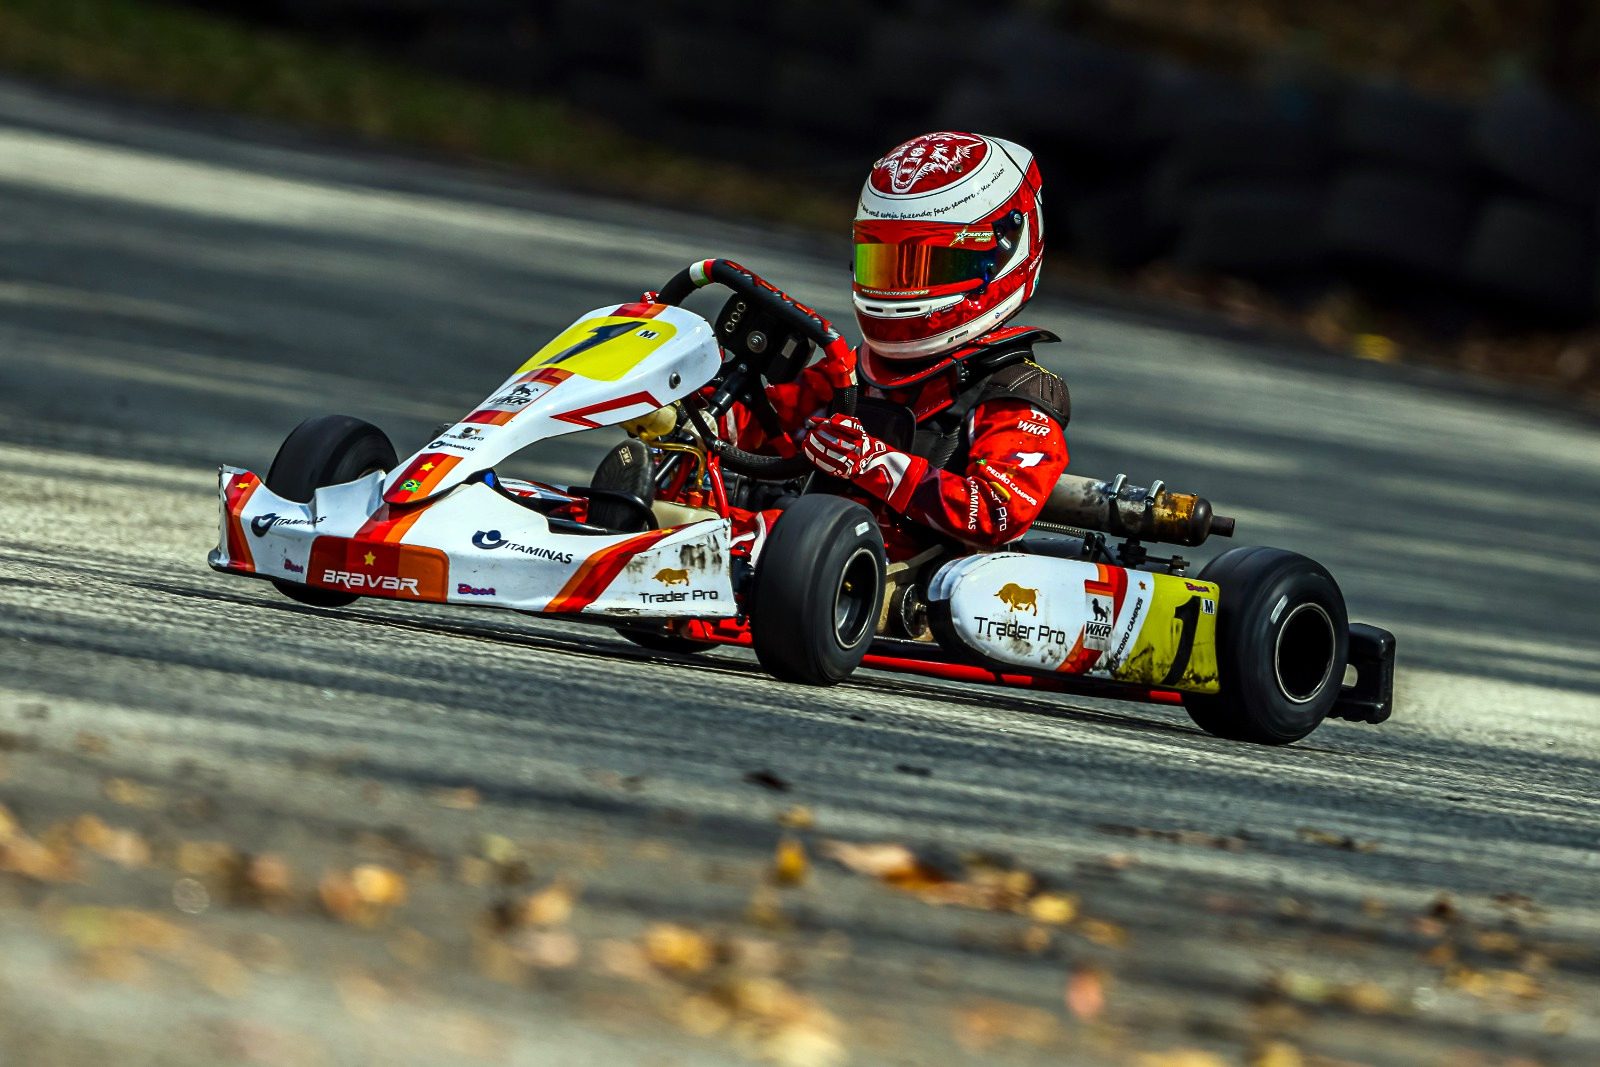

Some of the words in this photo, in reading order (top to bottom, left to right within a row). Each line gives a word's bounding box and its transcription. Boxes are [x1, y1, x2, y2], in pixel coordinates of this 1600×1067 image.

[538, 321, 648, 366] 1
[639, 330, 656, 338] M
[1017, 420, 1050, 436] WKR
[1010, 483, 1037, 506] CAMPOS
[996, 506, 1008, 531] Pro
[638, 591, 689, 604] Trader
[692, 589, 718, 601] Pro
[1204, 599, 1214, 614] M
[974, 616, 1036, 641] Trader
[1037, 625, 1067, 645] Pro
[1085, 622, 1112, 638] WKR
[1114, 631, 1130, 660] PEDRO
[1127, 597, 1144, 632] CAMPOS
[1160, 595, 1201, 686] 1
